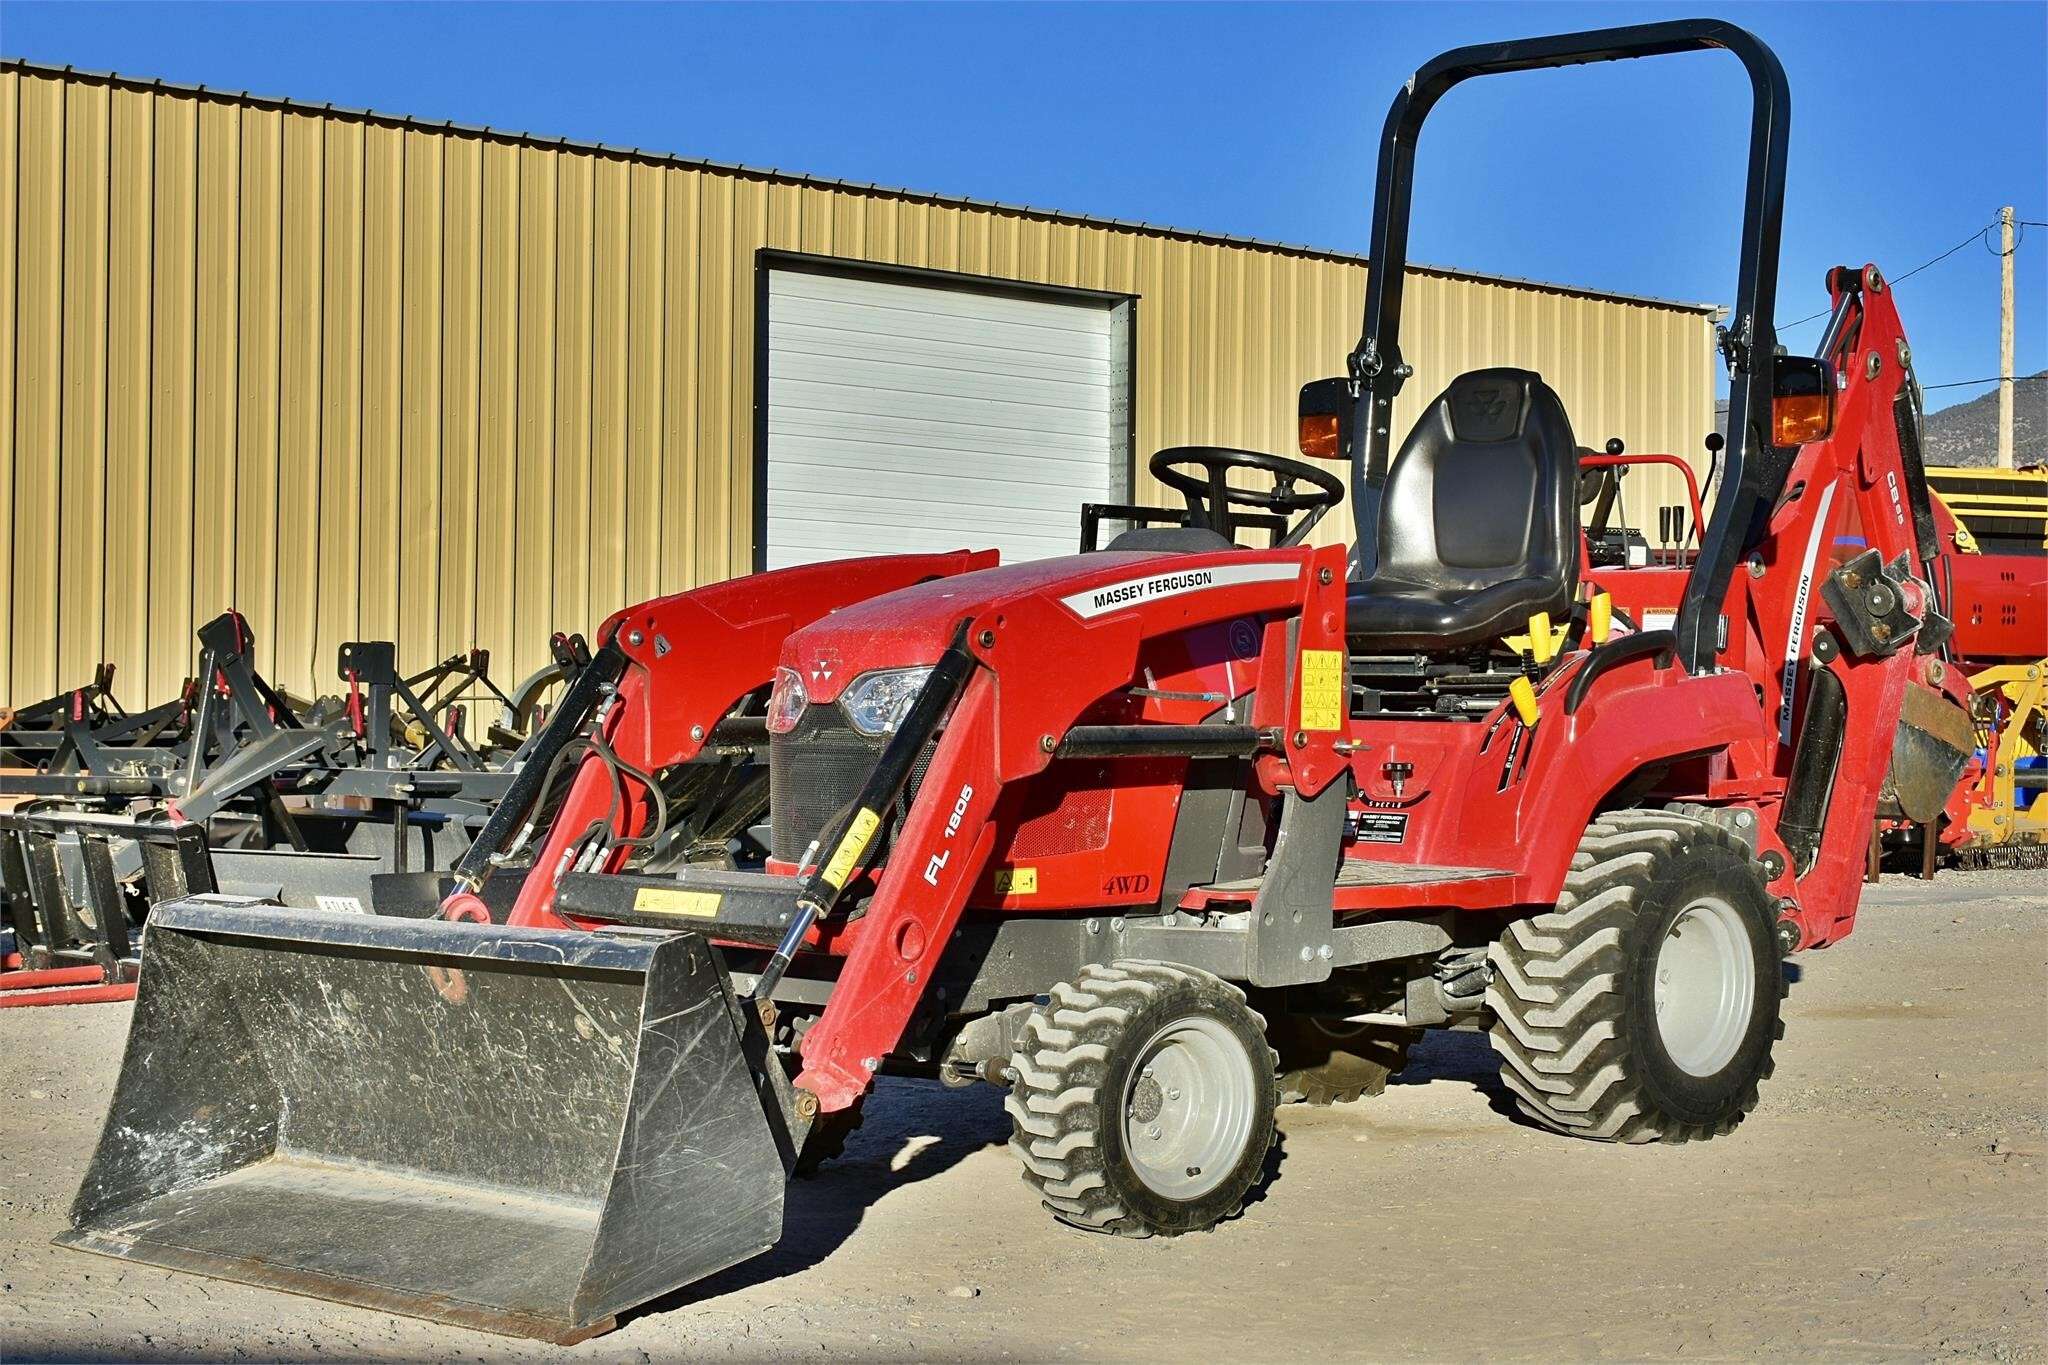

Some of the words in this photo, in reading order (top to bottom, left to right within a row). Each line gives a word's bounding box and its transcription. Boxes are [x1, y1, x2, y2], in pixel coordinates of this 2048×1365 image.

[1093, 584, 1144, 608] MASSEY
[1148, 571, 1213, 595] FERGUSON
[1783, 658, 1795, 721] MASSEY
[1790, 574, 1810, 654] FERGUSON
[923, 848, 950, 887] FL
[944, 783, 973, 839] 1805
[1102, 874, 1150, 895] 4WD
